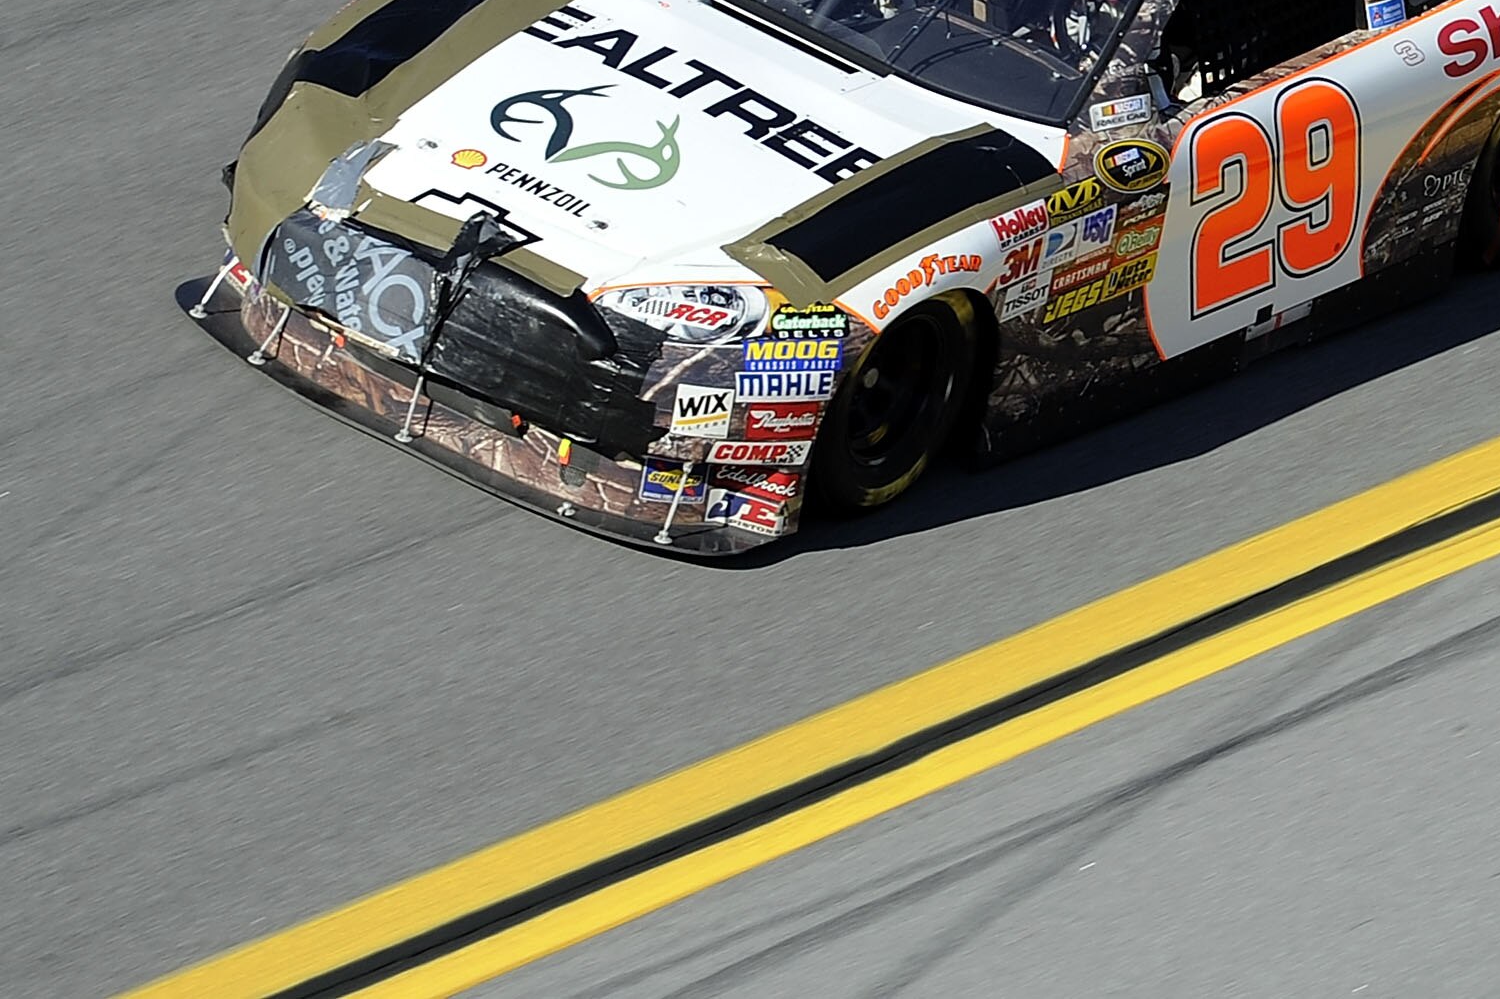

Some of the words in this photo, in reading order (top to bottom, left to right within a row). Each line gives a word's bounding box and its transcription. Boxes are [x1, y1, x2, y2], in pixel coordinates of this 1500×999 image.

[1393, 39, 1426, 67] 3
[522, 5, 887, 185] EALTREE
[1096, 115, 1126, 128] RACE
[1126, 111, 1149, 122] CAR
[1122, 159, 1148, 178] Sprint
[485, 163, 591, 217] PENNZOIL
[1189, 77, 1361, 319] 29
[992, 200, 1047, 242] Holley
[1082, 207, 1115, 244] USG
[1122, 208, 1158, 227] POLE
[1000, 237, 1044, 286] 3M
[1052, 257, 1111, 292] CRAFTSMAN
[1118, 258, 1150, 280] Auto
[873, 253, 983, 320] GOODYEAR
[1116, 268, 1153, 291] Meter
[1004, 284, 1050, 314] TISSOT
[1043, 279, 1106, 324] JEGS
[666, 303, 729, 327] RCR
[772, 313, 847, 331] Gatorback
[778, 330, 845, 339] BELTS
[746, 339, 839, 361] MOOG
[750, 361, 797, 371] CHASSIS
[802, 360, 836, 371] PARTS
[738, 372, 832, 397] MAHLE
[677, 391, 731, 418] WIX
[714, 444, 788, 461] COMP
[716, 464, 797, 497] Edelbrock
[708, 493, 778, 528] JE
[729, 517, 781, 535] PISTONS
